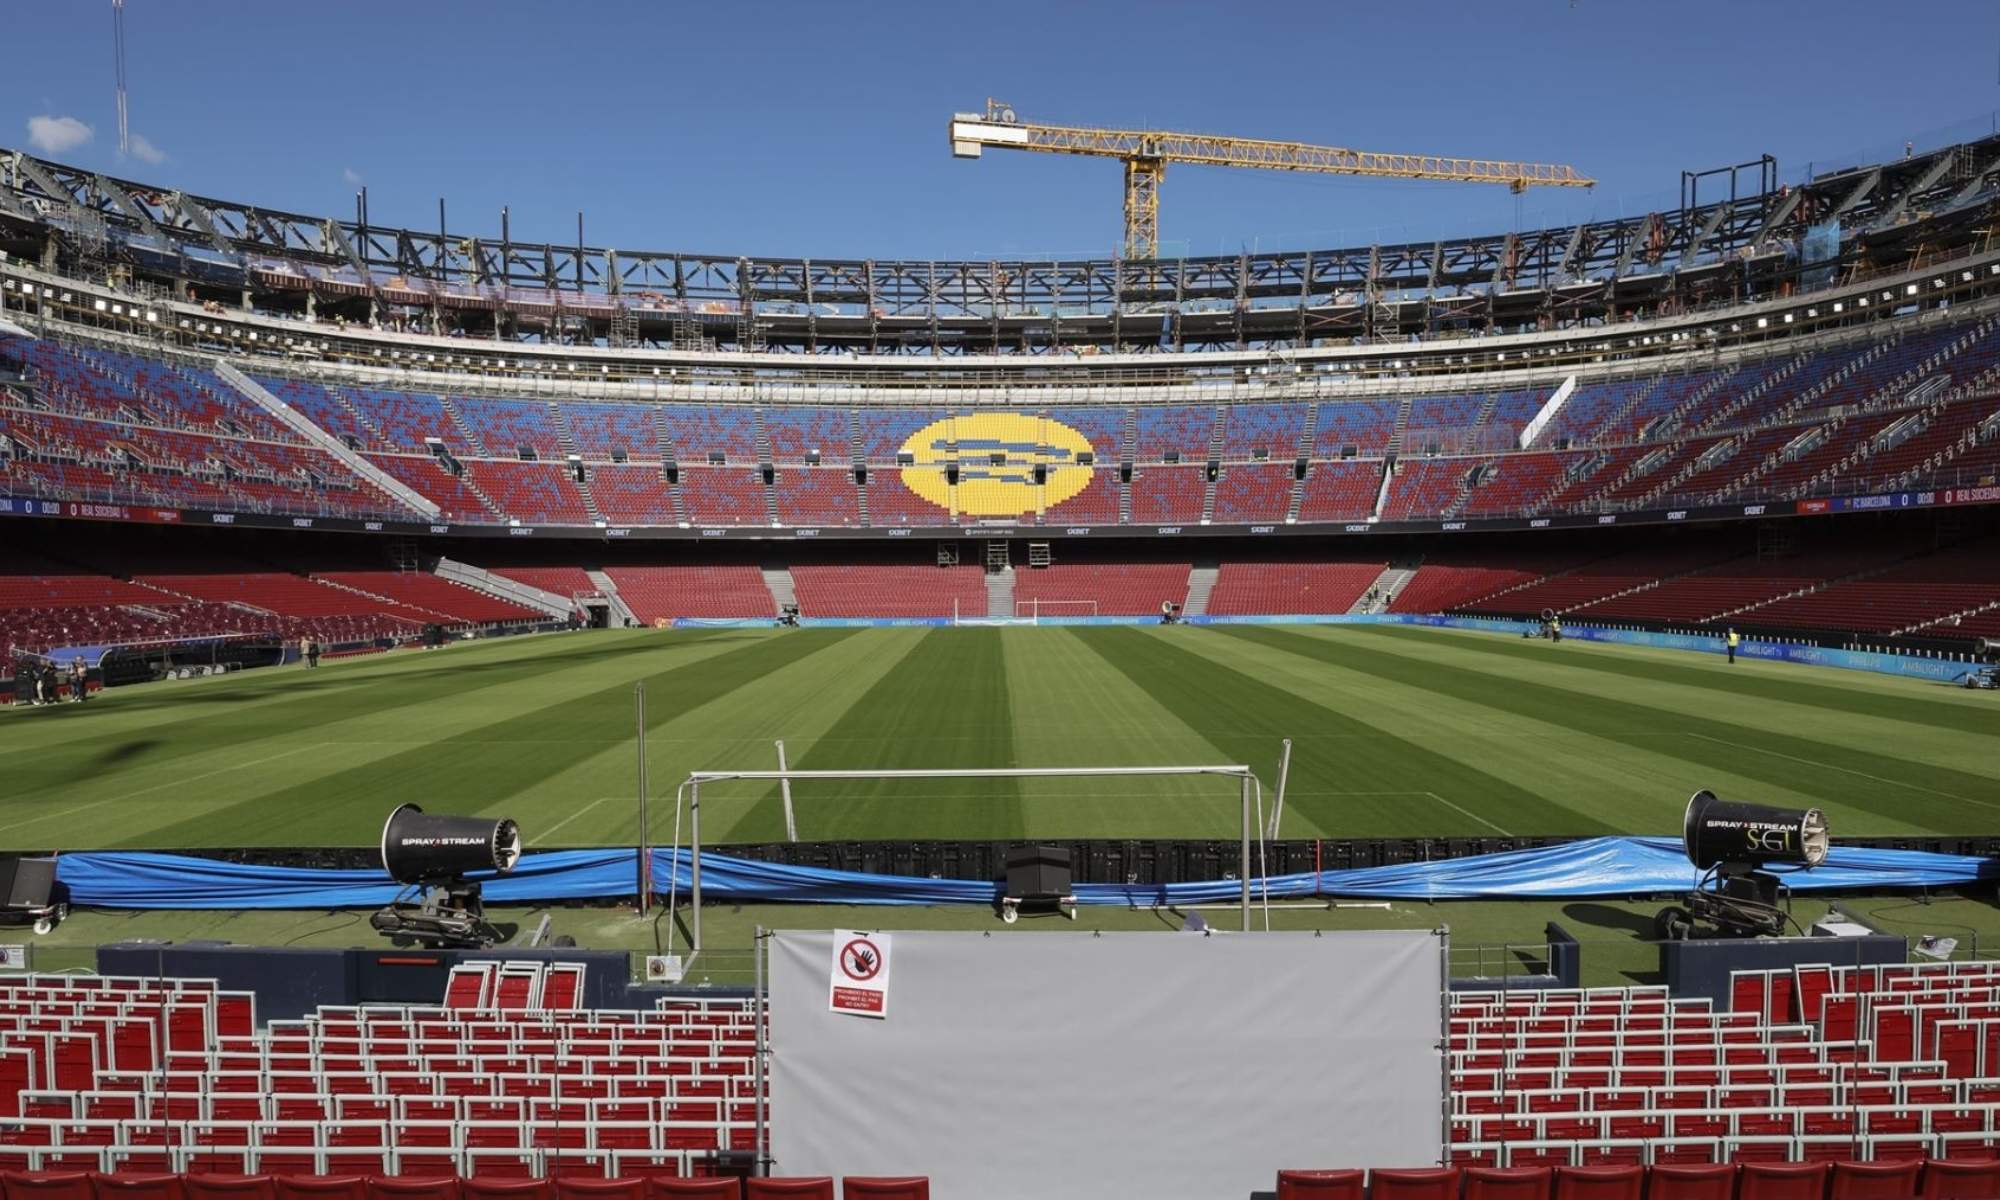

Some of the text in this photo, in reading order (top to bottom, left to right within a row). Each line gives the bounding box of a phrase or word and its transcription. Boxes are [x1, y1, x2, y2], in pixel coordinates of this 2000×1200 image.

[1902, 661, 1944, 675] AMBILIGHT
[1707, 820, 1797, 831] SPRAY STREAM
